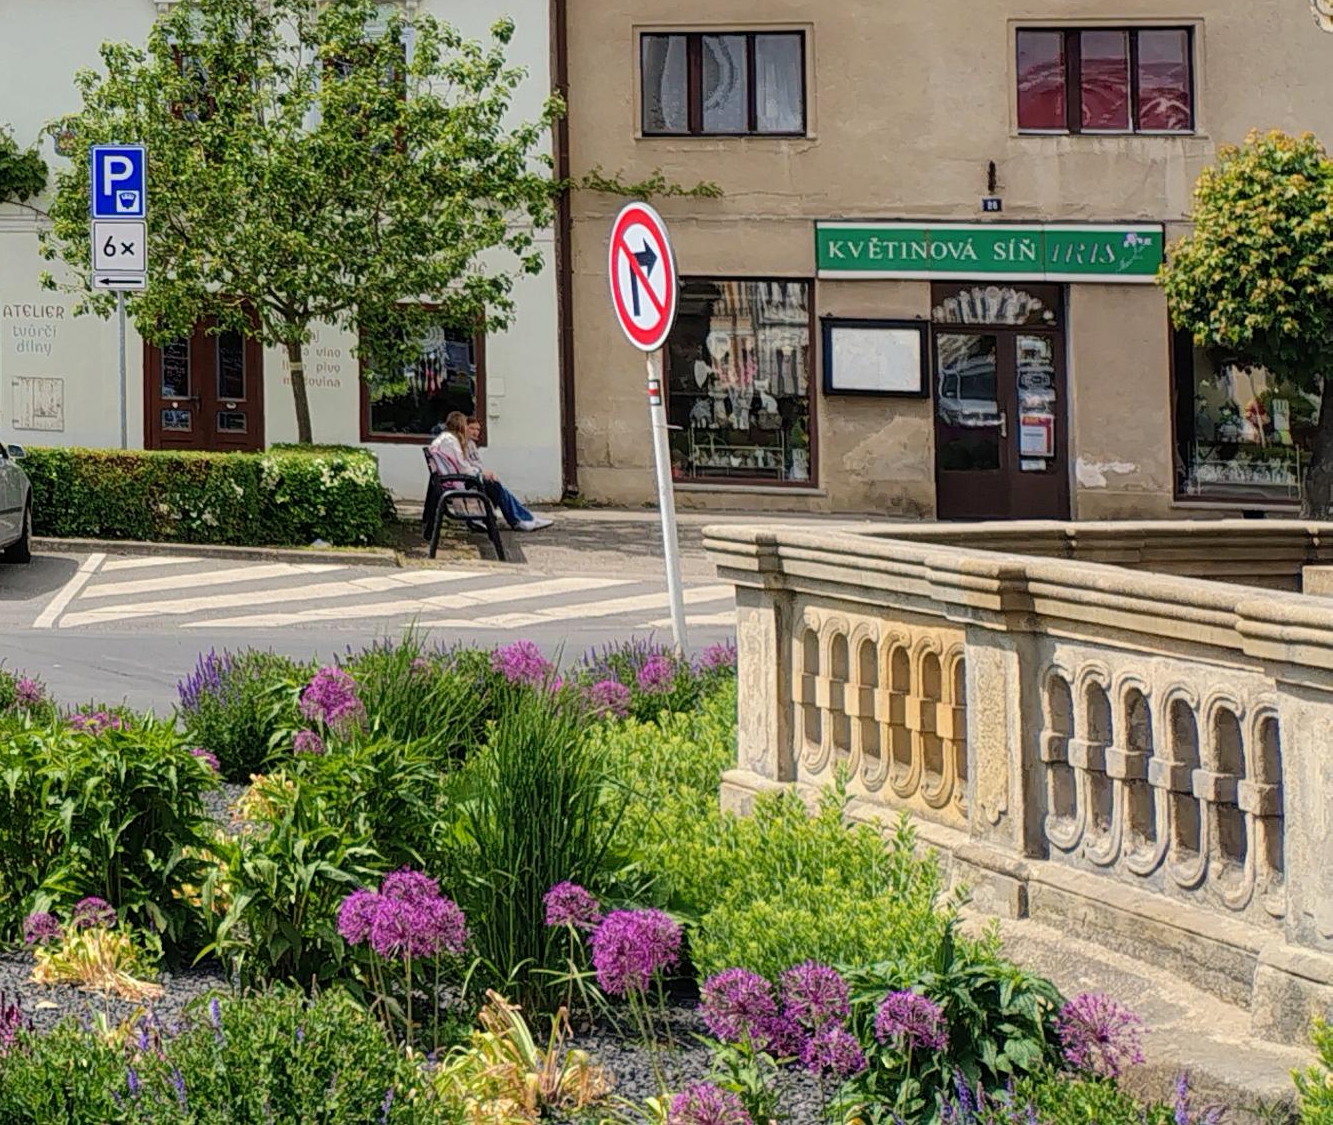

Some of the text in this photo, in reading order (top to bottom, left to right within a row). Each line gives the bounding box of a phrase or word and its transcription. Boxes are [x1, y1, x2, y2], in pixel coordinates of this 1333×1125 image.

[103, 155, 134, 196] P
[828, 237, 1116, 264] KVĚTINOVÁ SÍŇ IRIS
[3, 304, 65, 319] ATELIER
